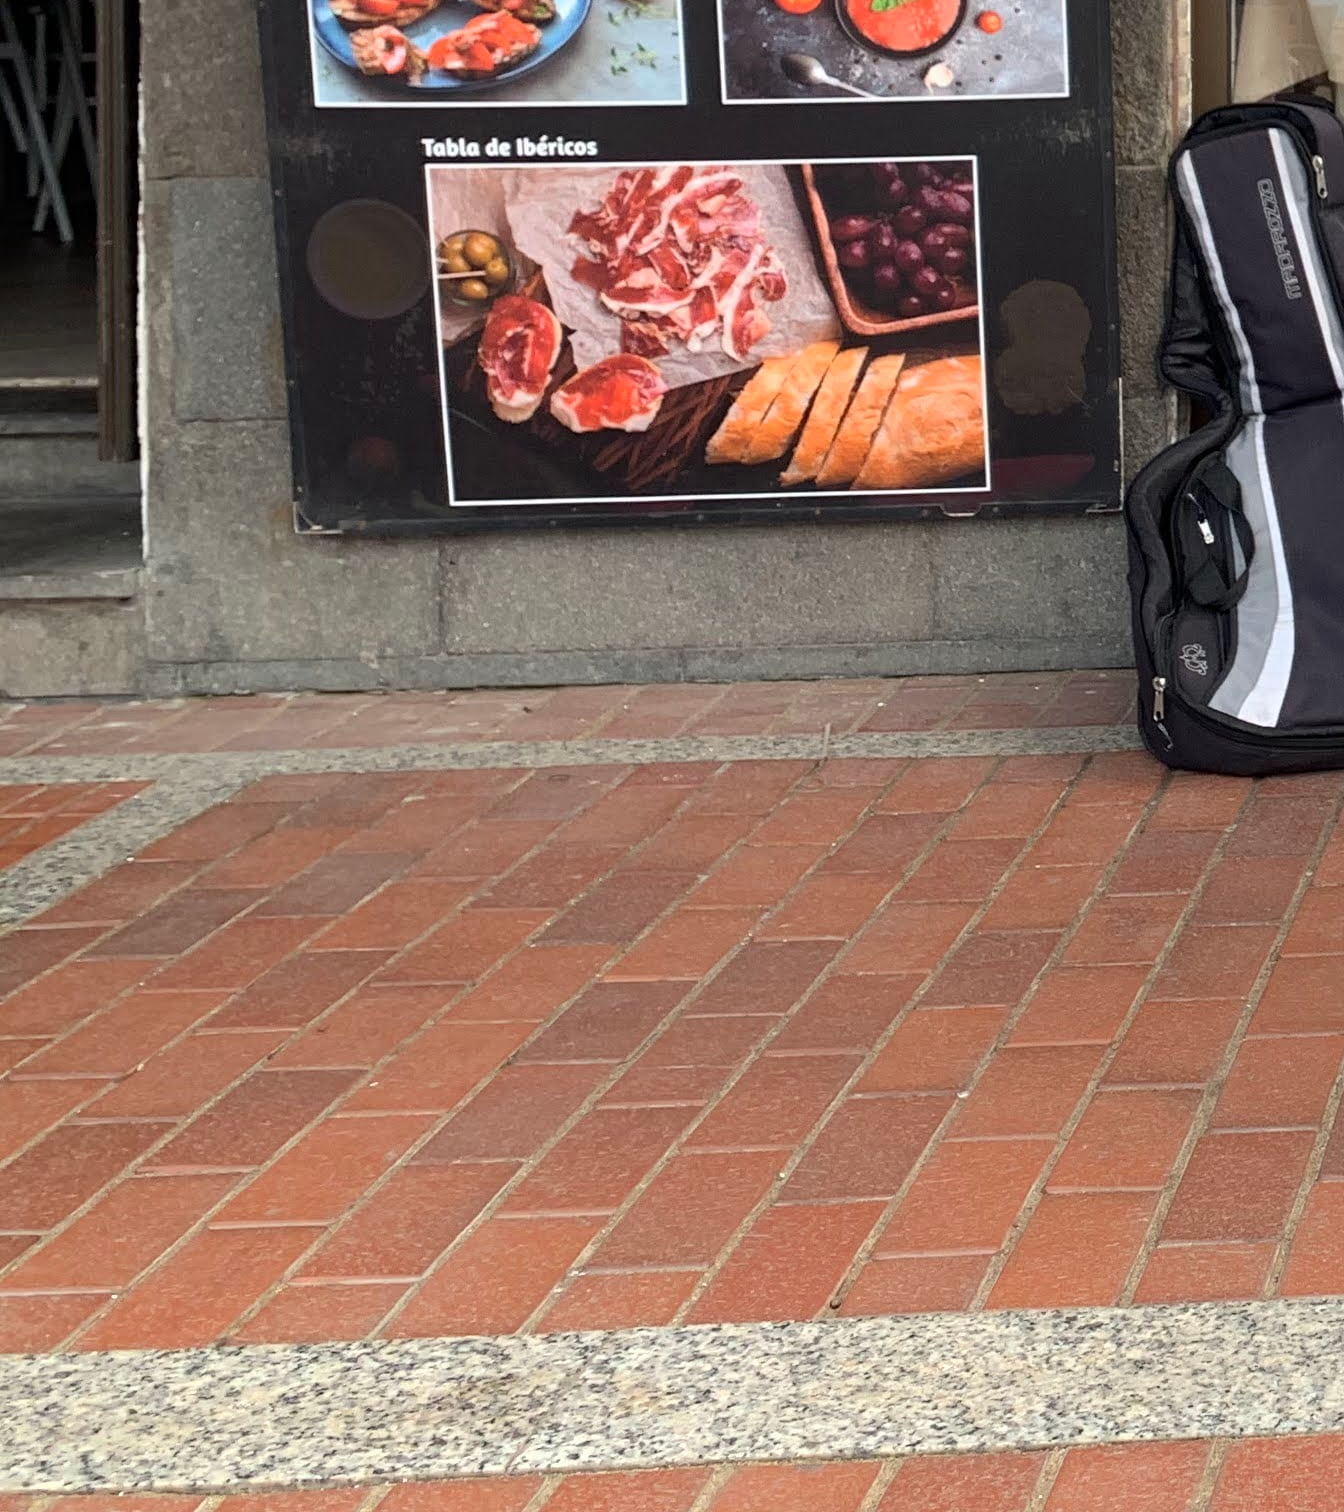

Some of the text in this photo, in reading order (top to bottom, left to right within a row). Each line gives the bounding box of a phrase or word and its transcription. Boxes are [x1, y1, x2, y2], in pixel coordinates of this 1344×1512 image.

[421, 134, 598, 157] Tabla de Ibéricos
